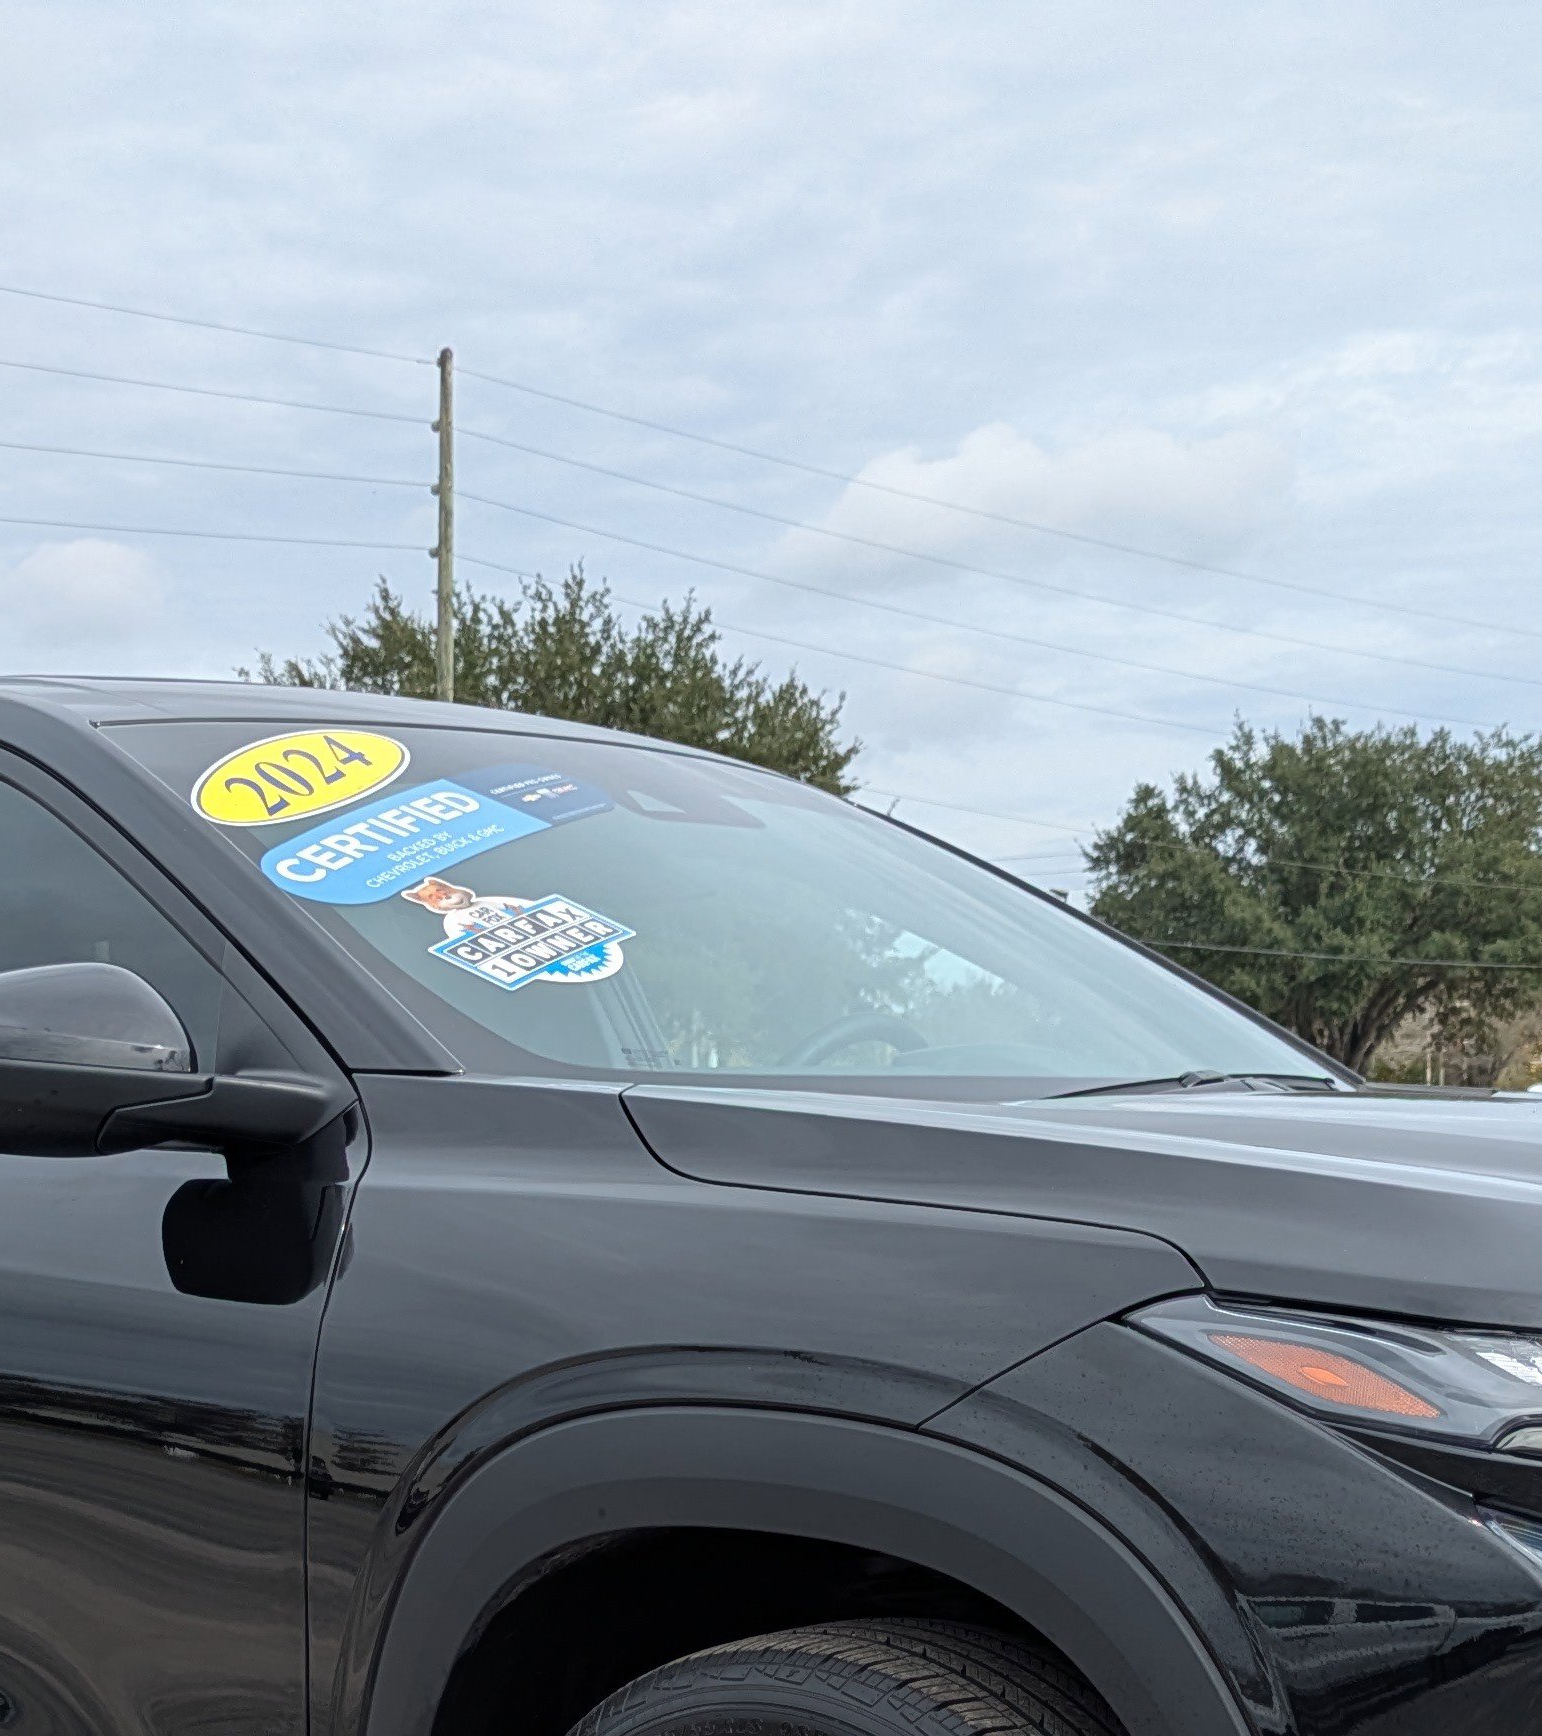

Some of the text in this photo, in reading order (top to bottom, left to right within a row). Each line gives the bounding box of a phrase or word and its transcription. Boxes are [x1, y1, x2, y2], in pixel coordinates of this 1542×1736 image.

[225, 735, 373, 816] 2024
[276, 791, 481, 883] CERTIFIED
[365, 848, 440, 889] CHEVROLET,
[433, 836, 467, 857] BUICK
[477, 824, 505, 839] GMC
[387, 831, 453, 862] BACKED BY
[457, 907, 584, 961] CARFAX
[469, 906, 494, 919] CAR
[483, 913, 508, 927] FOX
